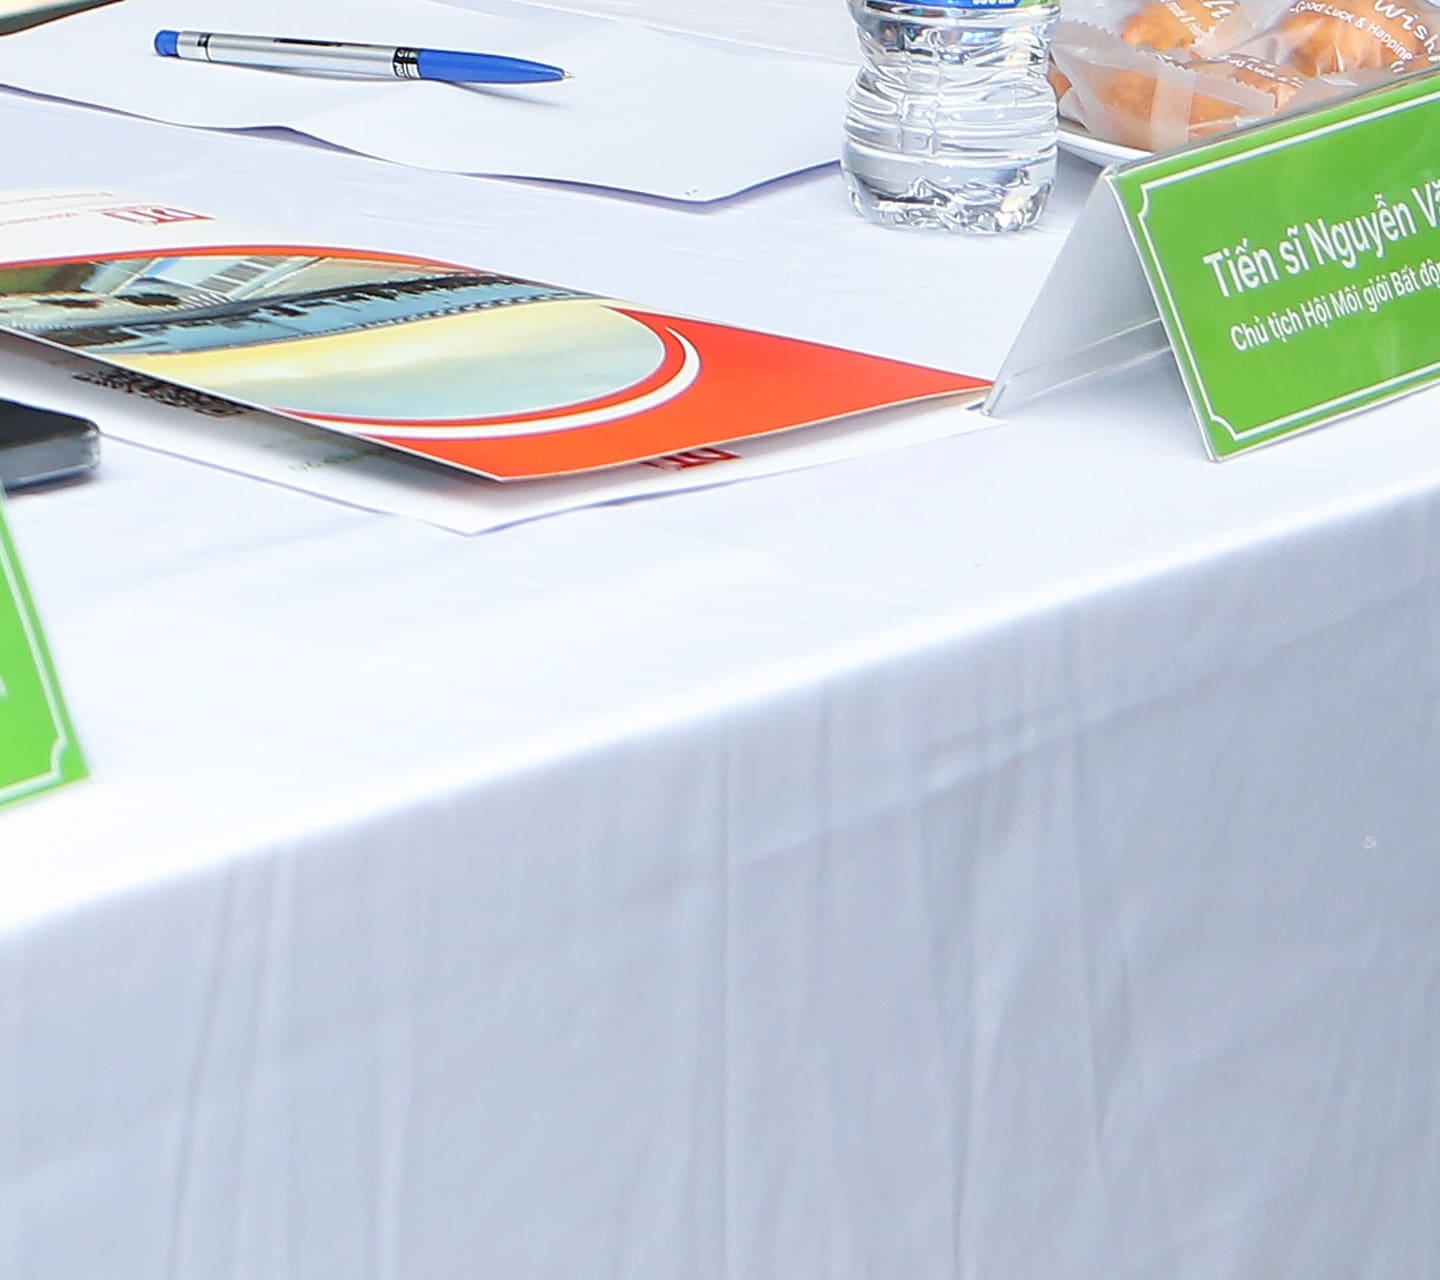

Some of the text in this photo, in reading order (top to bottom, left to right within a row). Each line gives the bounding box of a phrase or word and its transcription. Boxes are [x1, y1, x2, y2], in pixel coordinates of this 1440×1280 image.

[1325, 4, 1356, 24] Luck
[1354, 16, 1369, 30] &
[1366, 22, 1414, 66] Happine
[1203, 237, 1280, 297] Tiến
[1279, 225, 1310, 275] sĩ
[1304, 193, 1418, 269] Nguyễn
[1230, 315, 1270, 351] Chủ
[1268, 306, 1304, 343] tịch
[1300, 294, 1333, 328] Hội
[1329, 285, 1363, 320] Môi
[1362, 274, 1394, 313] giới
[1390, 264, 1422, 297] Bất
